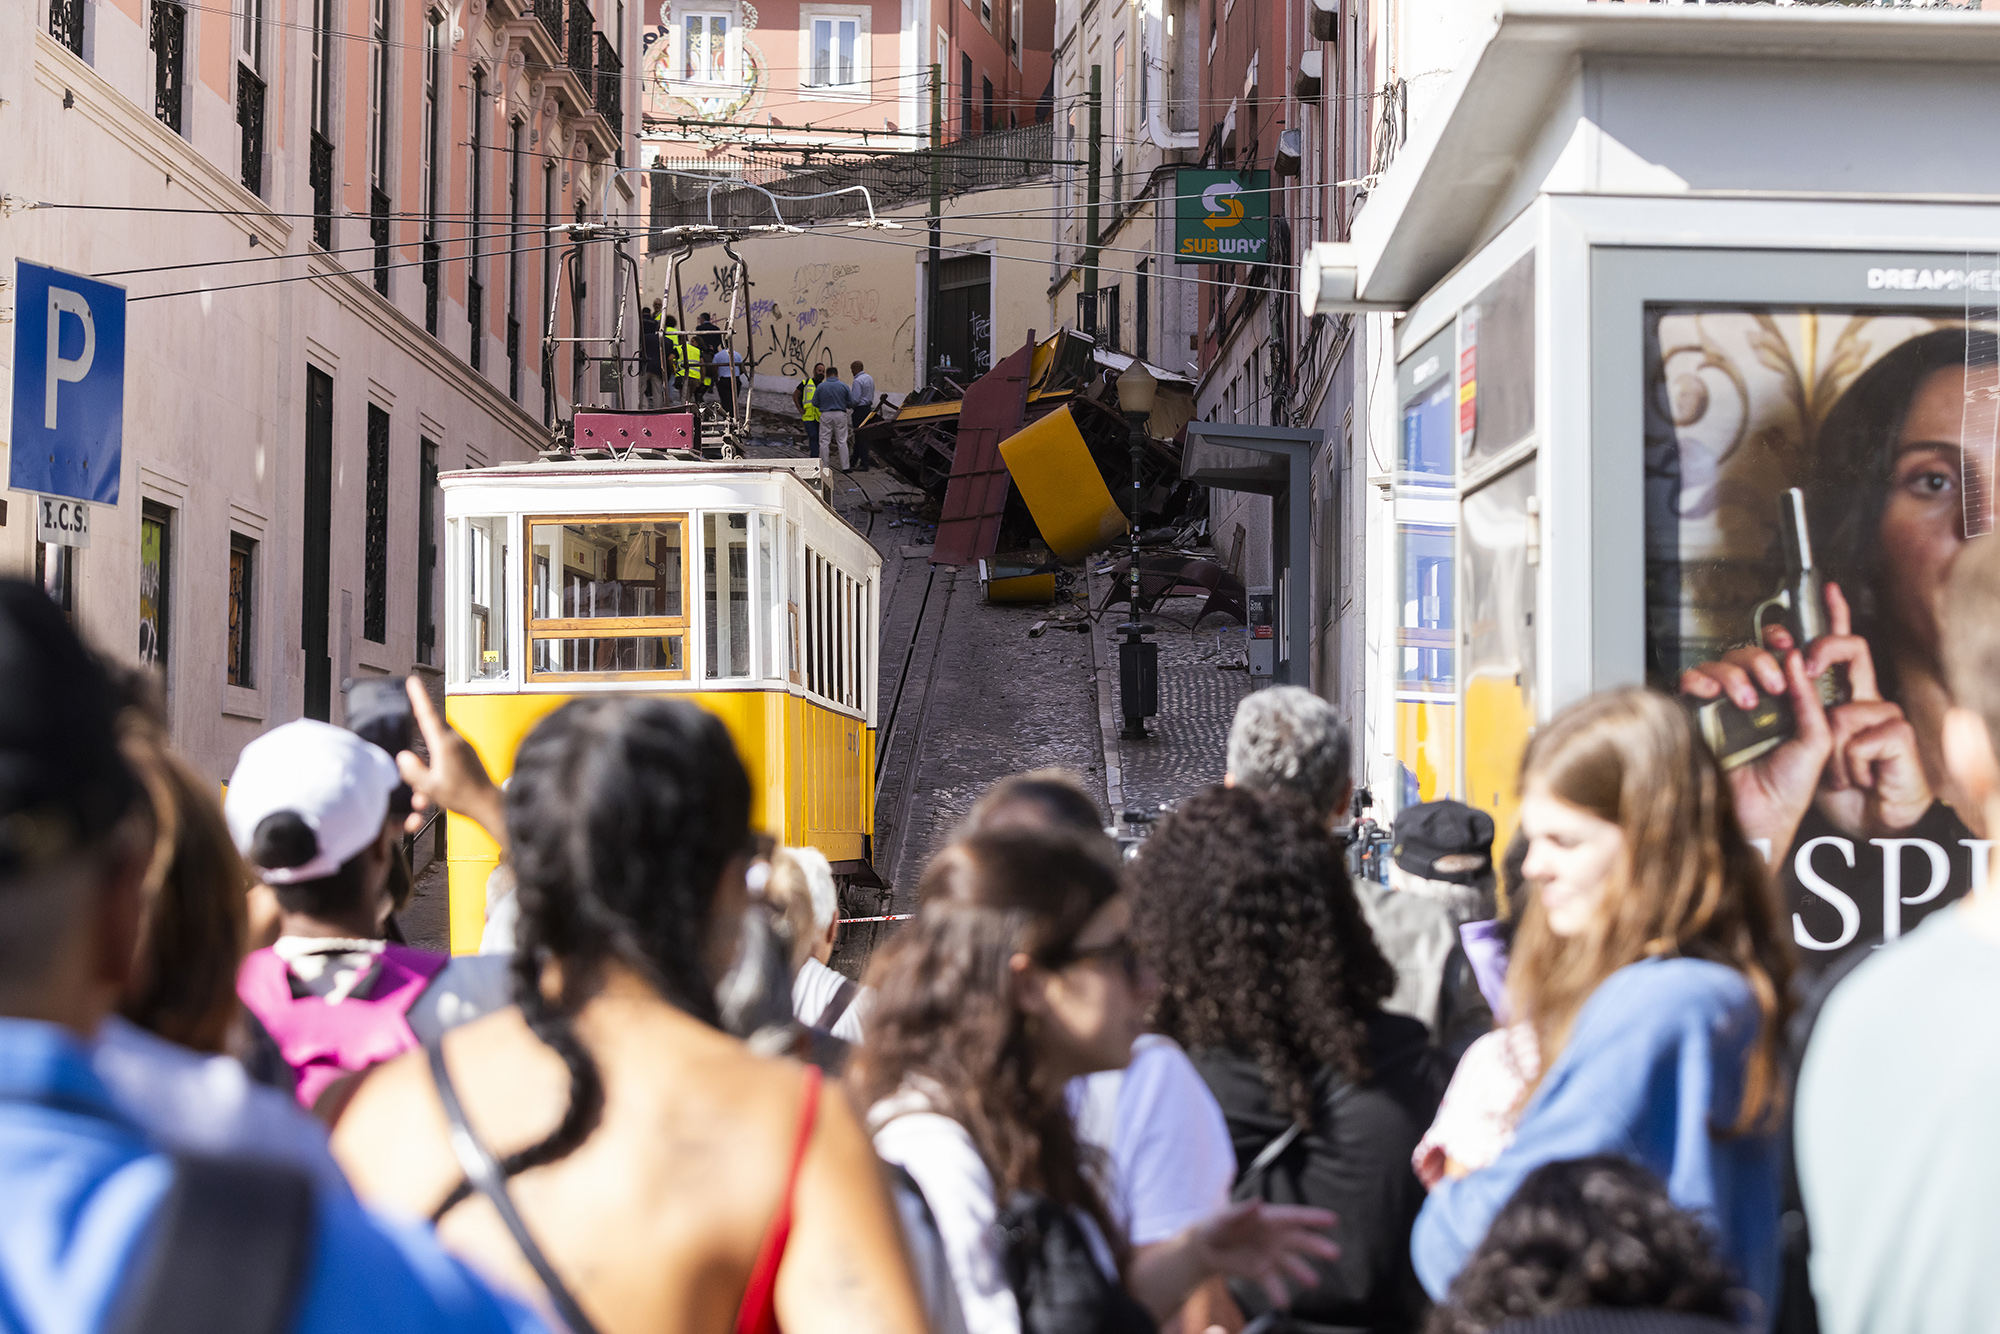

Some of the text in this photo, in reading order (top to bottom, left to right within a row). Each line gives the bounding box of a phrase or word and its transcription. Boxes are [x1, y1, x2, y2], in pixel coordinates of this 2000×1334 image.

[1180, 238, 1264, 254] SUBWAY
[45, 286, 95, 430] P
[44, 501, 87, 533] I.C.S.
